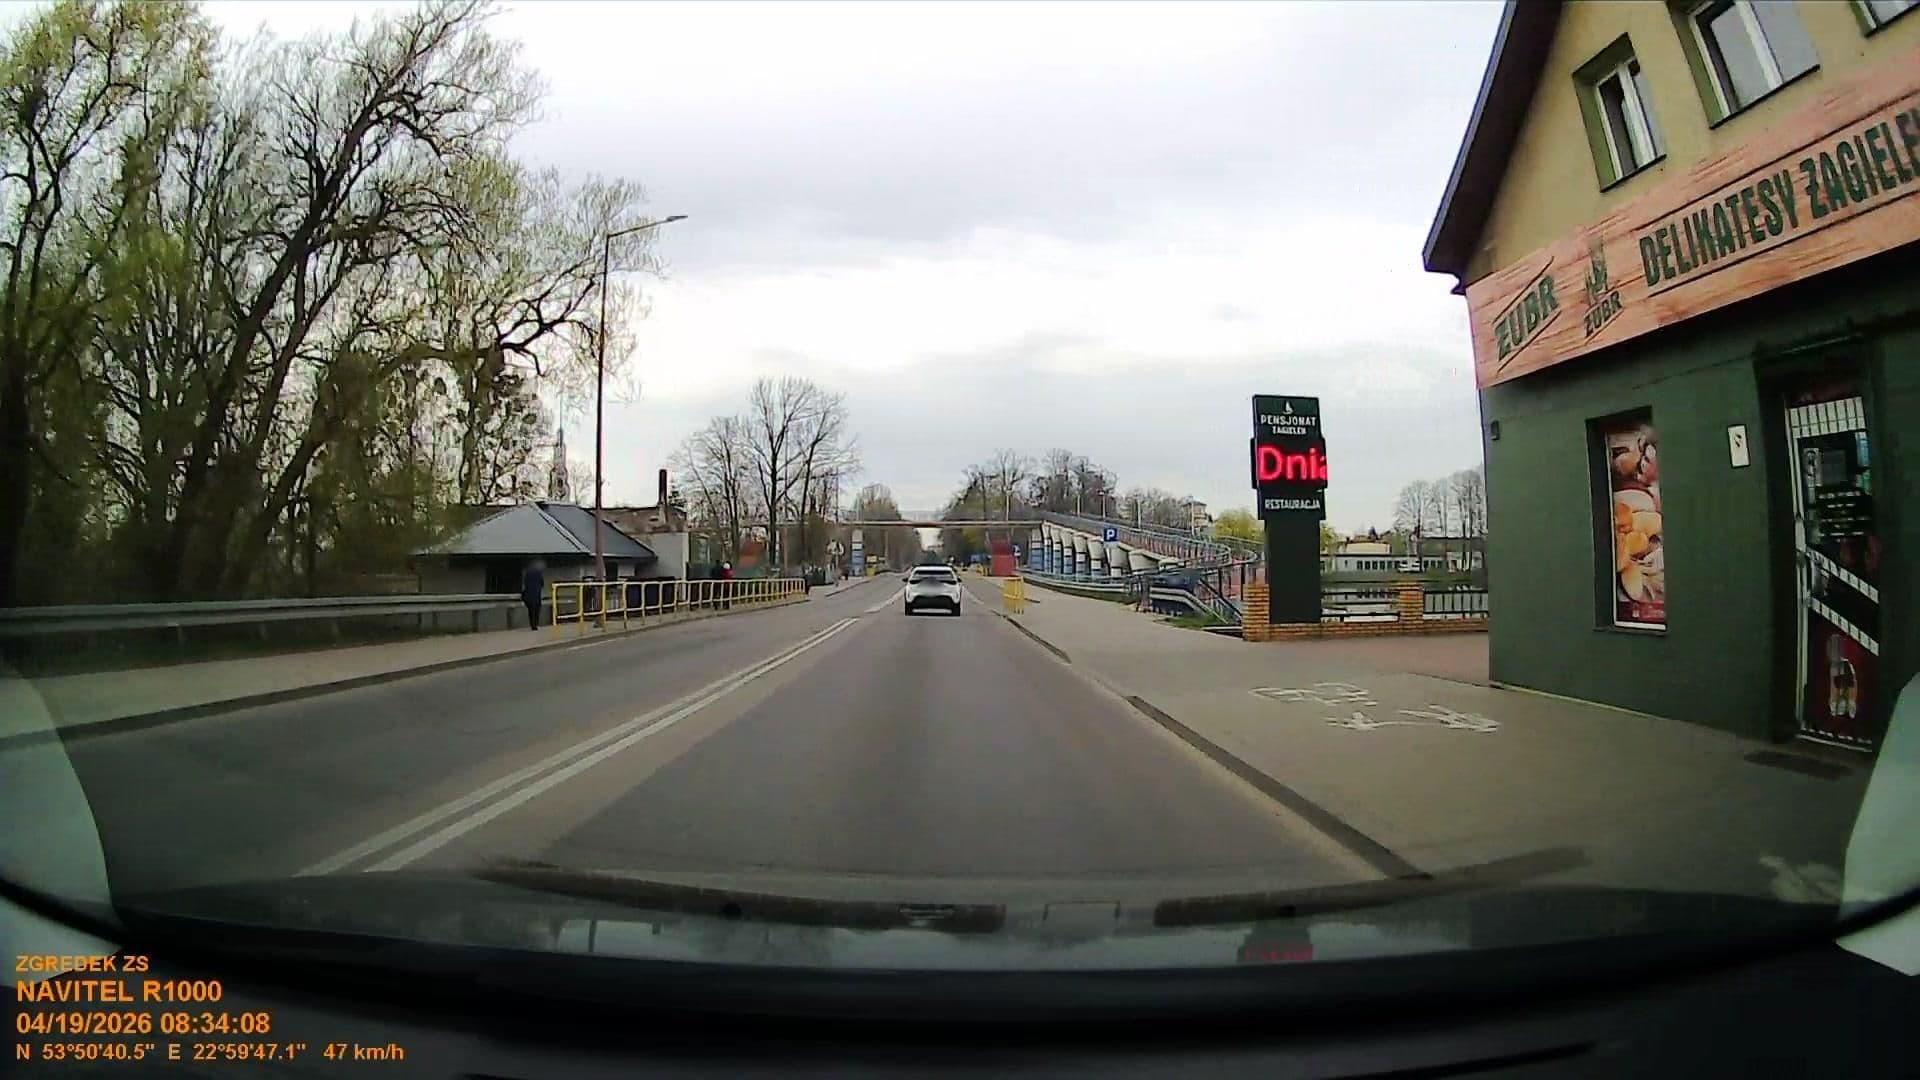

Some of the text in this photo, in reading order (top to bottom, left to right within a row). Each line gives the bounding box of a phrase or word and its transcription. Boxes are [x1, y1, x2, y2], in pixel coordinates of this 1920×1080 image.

[1639, 169, 1798, 287] DELIKATESY
[1260, 414, 1317, 426] PENSJONAT
[1264, 499, 1321, 511] RESTAURACJA
[1106, 529, 1115, 540] P
